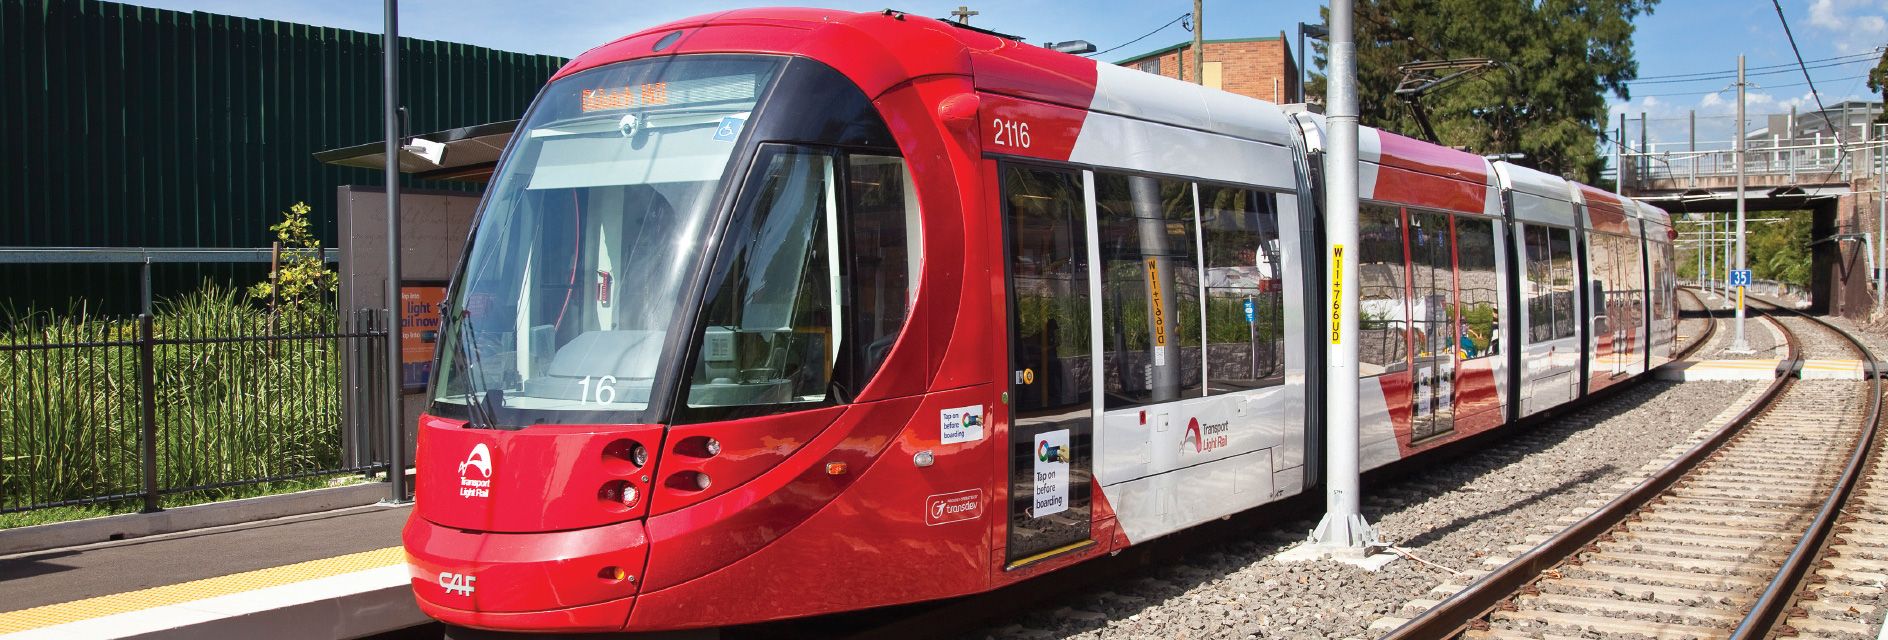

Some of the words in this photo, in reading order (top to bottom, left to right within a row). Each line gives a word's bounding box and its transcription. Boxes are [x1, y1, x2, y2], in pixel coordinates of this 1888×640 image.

[993, 118, 1030, 148] 2116
[1734, 271, 1747, 285] 35
[407, 301, 431, 316] light
[400, 315, 414, 327] ail
[416, 318, 439, 327] now
[577, 374, 617, 406] 16
[943, 413, 952, 421] Tap
[943, 422, 960, 430] before
[1203, 420, 1229, 435] Transport
[943, 430, 965, 439] boarding
[1203, 437, 1217, 452] Light
[1217, 434, 1228, 448] Rail
[460, 476, 490, 488] Transport
[1037, 471, 1047, 483] Tap
[1047, 470, 1056, 480] on
[460, 487, 475, 498] Light
[475, 488, 489, 498] Rail
[1036, 482, 1056, 495] before
[946, 501, 978, 514] transdev
[1036, 495, 1063, 509] boarding
[439, 571, 476, 597] CAF
